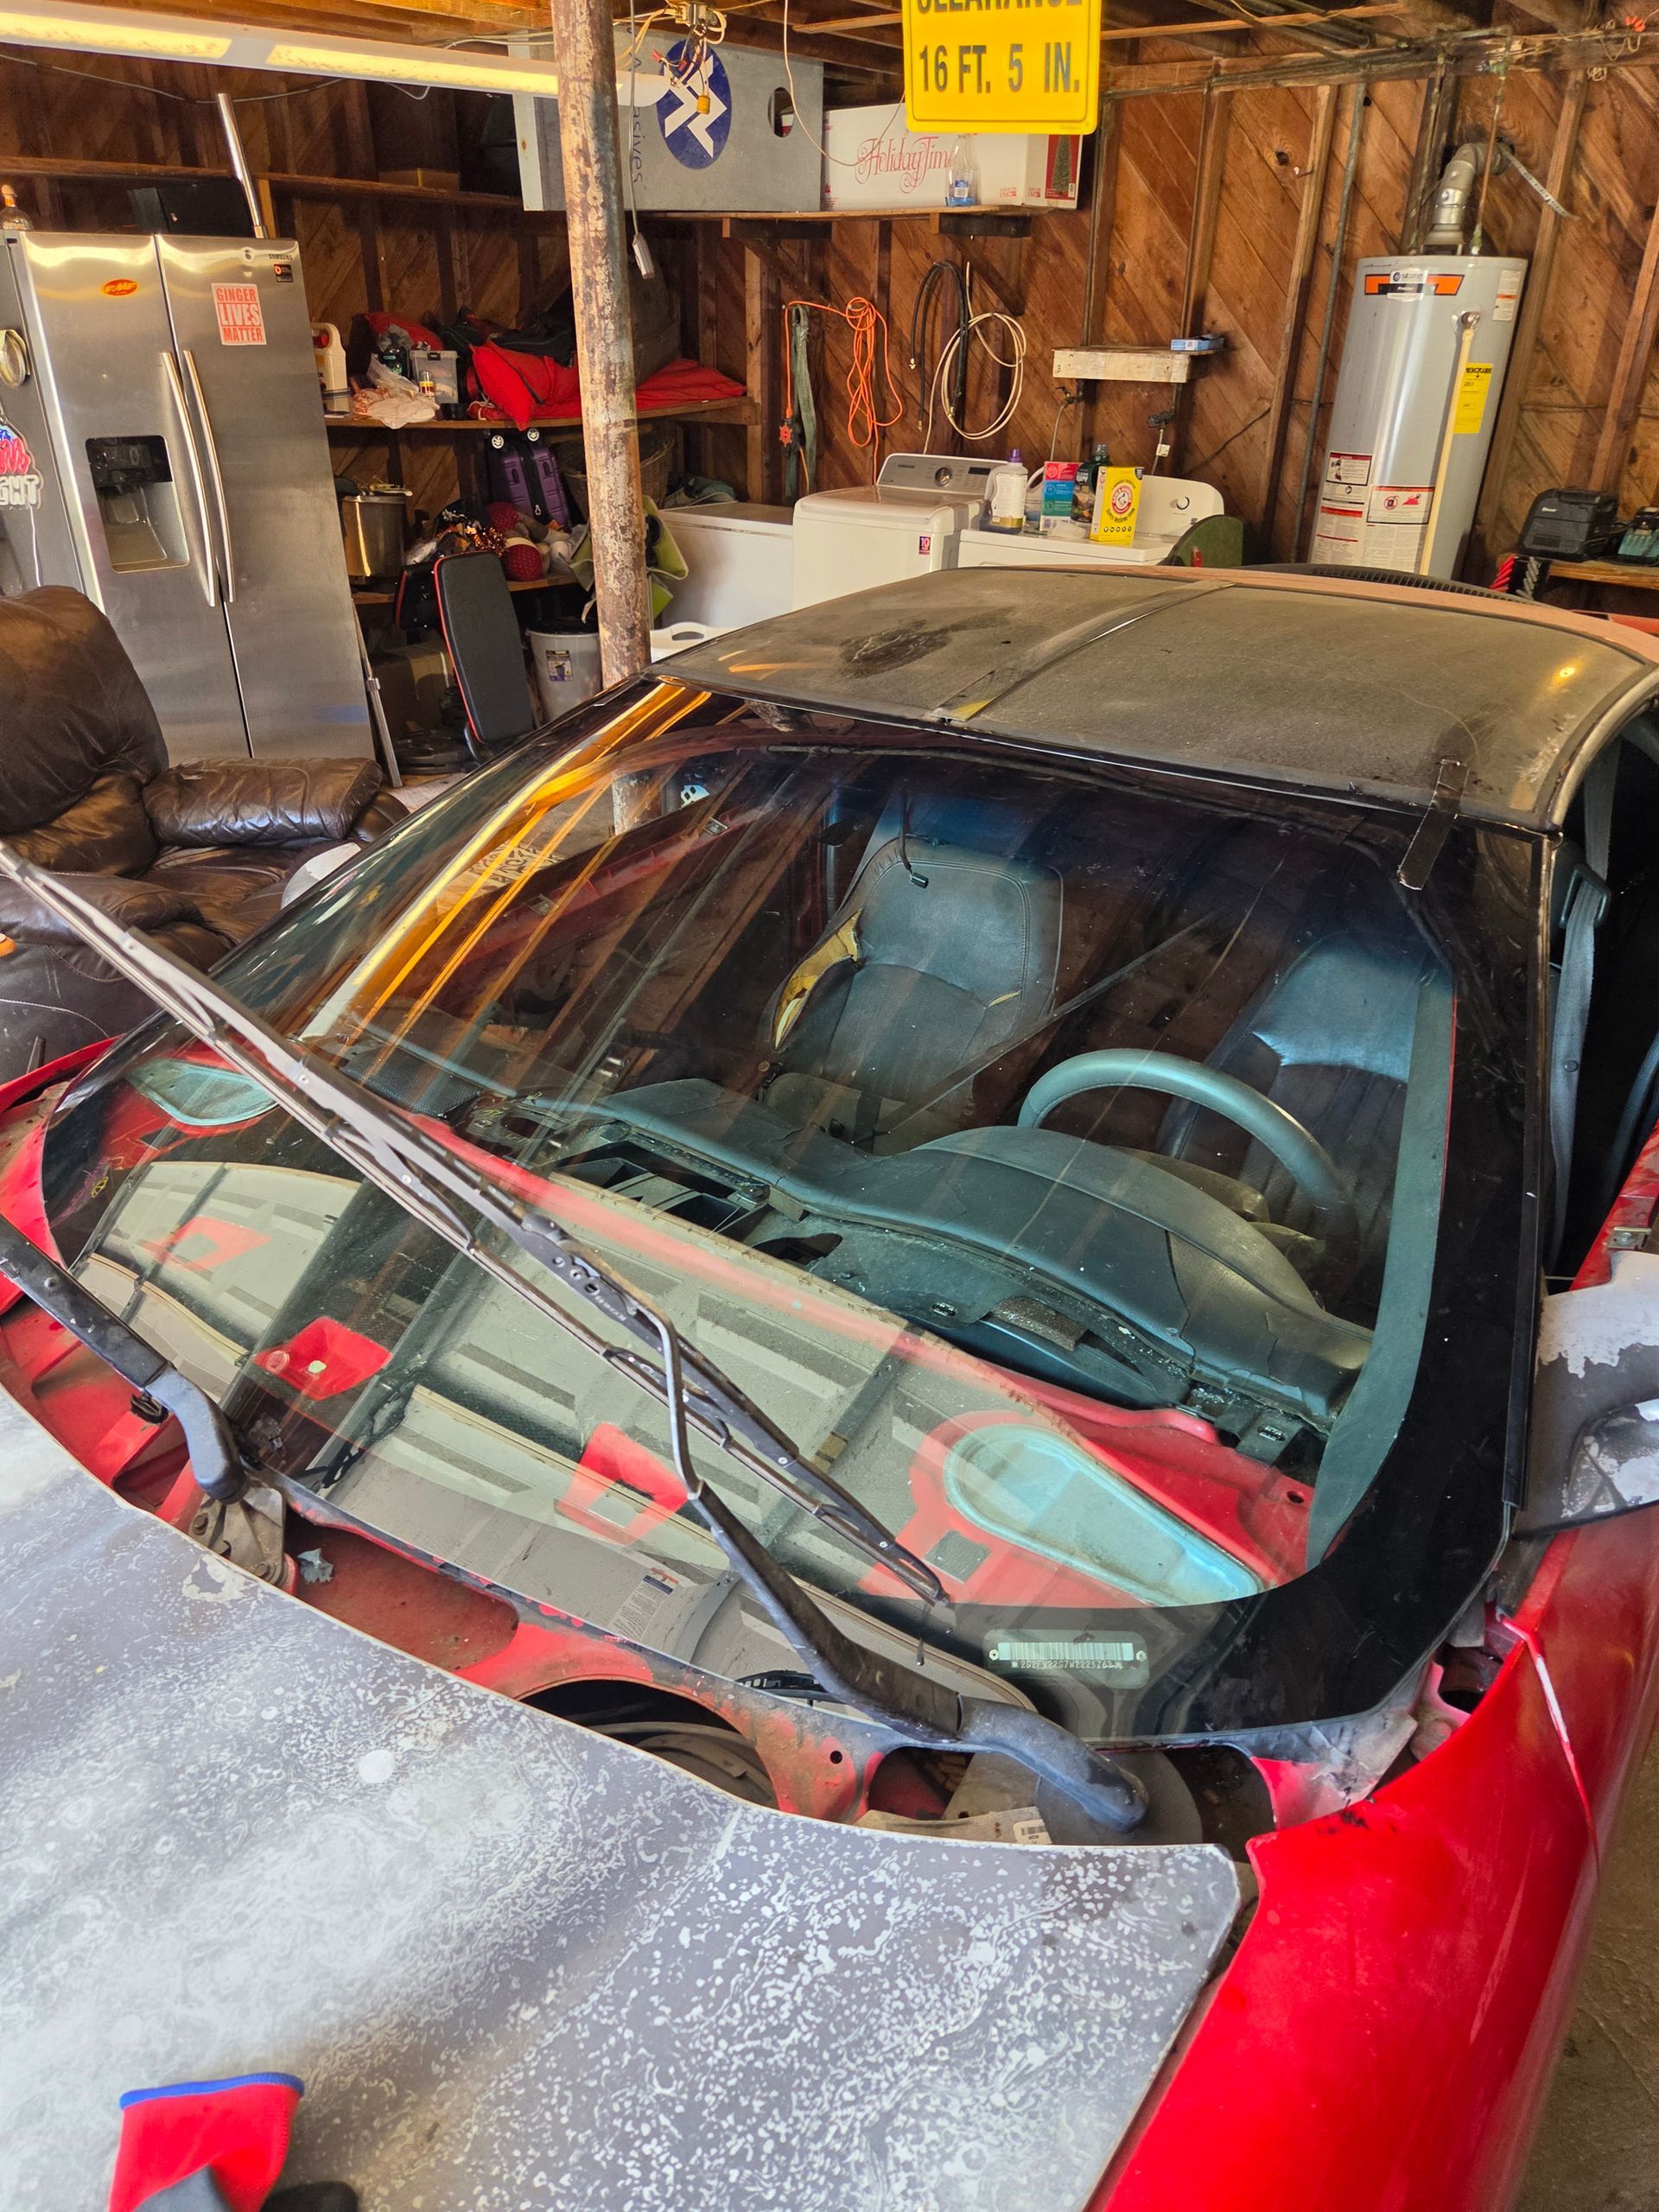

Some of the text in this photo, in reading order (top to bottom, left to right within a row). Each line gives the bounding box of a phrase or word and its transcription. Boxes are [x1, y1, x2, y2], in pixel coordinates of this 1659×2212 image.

[919, 41, 1080, 93] 16 FT. 5 IN.
[855, 137, 921, 188] Holiday
[216, 288, 257, 302] GINGER
[218, 303, 261, 326] LIVES
[222, 327, 263, 342] MATTER
